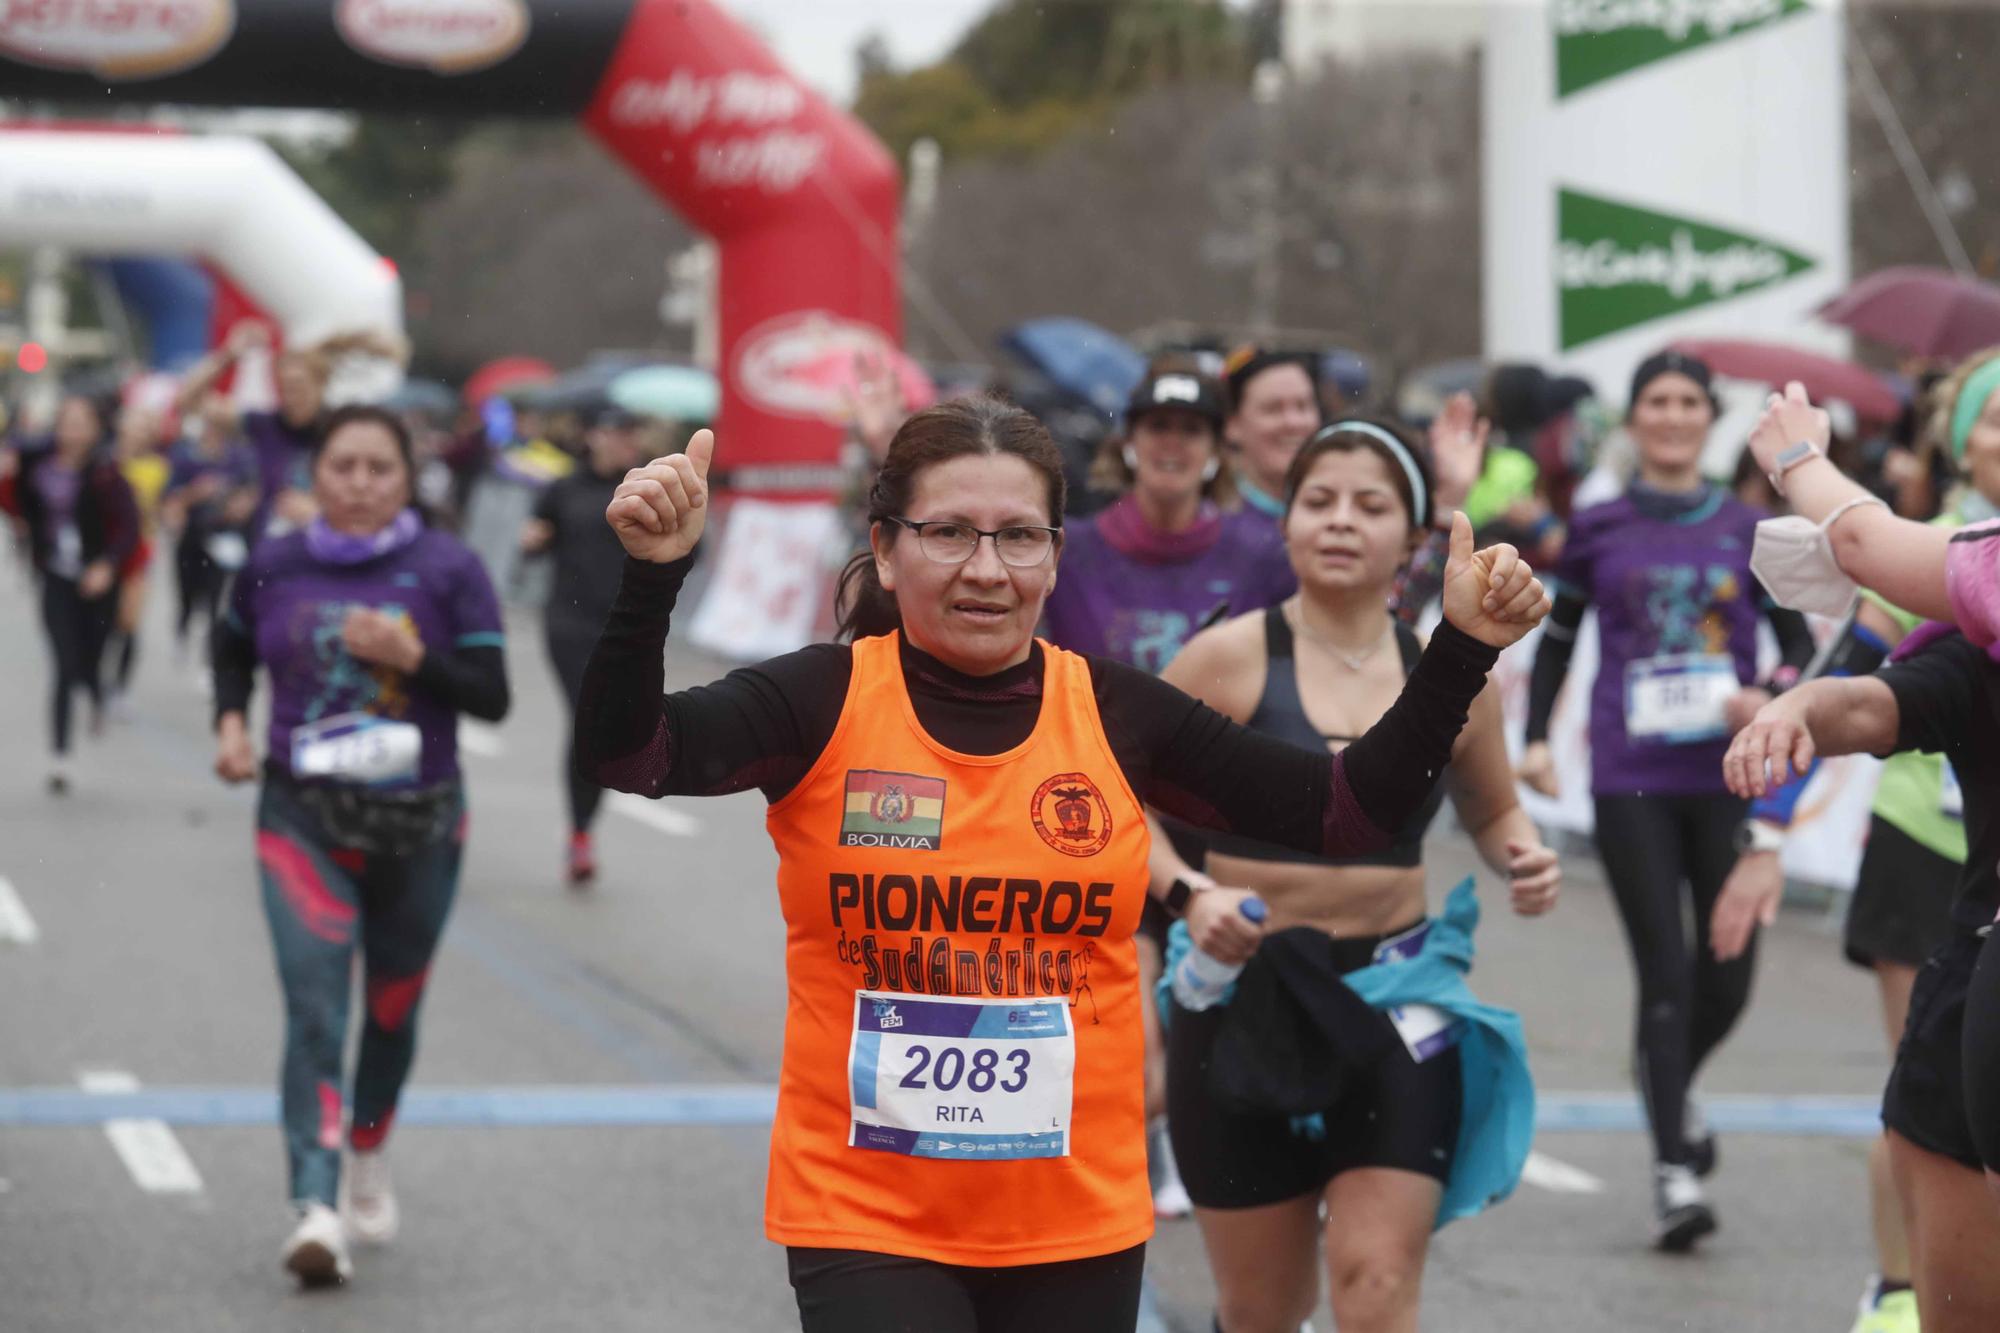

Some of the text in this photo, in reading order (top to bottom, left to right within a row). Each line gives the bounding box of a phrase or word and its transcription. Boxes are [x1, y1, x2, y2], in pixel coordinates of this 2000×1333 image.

[846, 833, 932, 850] BOLIVIA
[829, 873, 1115, 937] PIONEROS
[882, 1018, 901, 1027] FEM
[899, 1045, 1031, 1093] 2083
[936, 1105, 984, 1123] RITA
[1052, 1117, 1059, 1128] L
